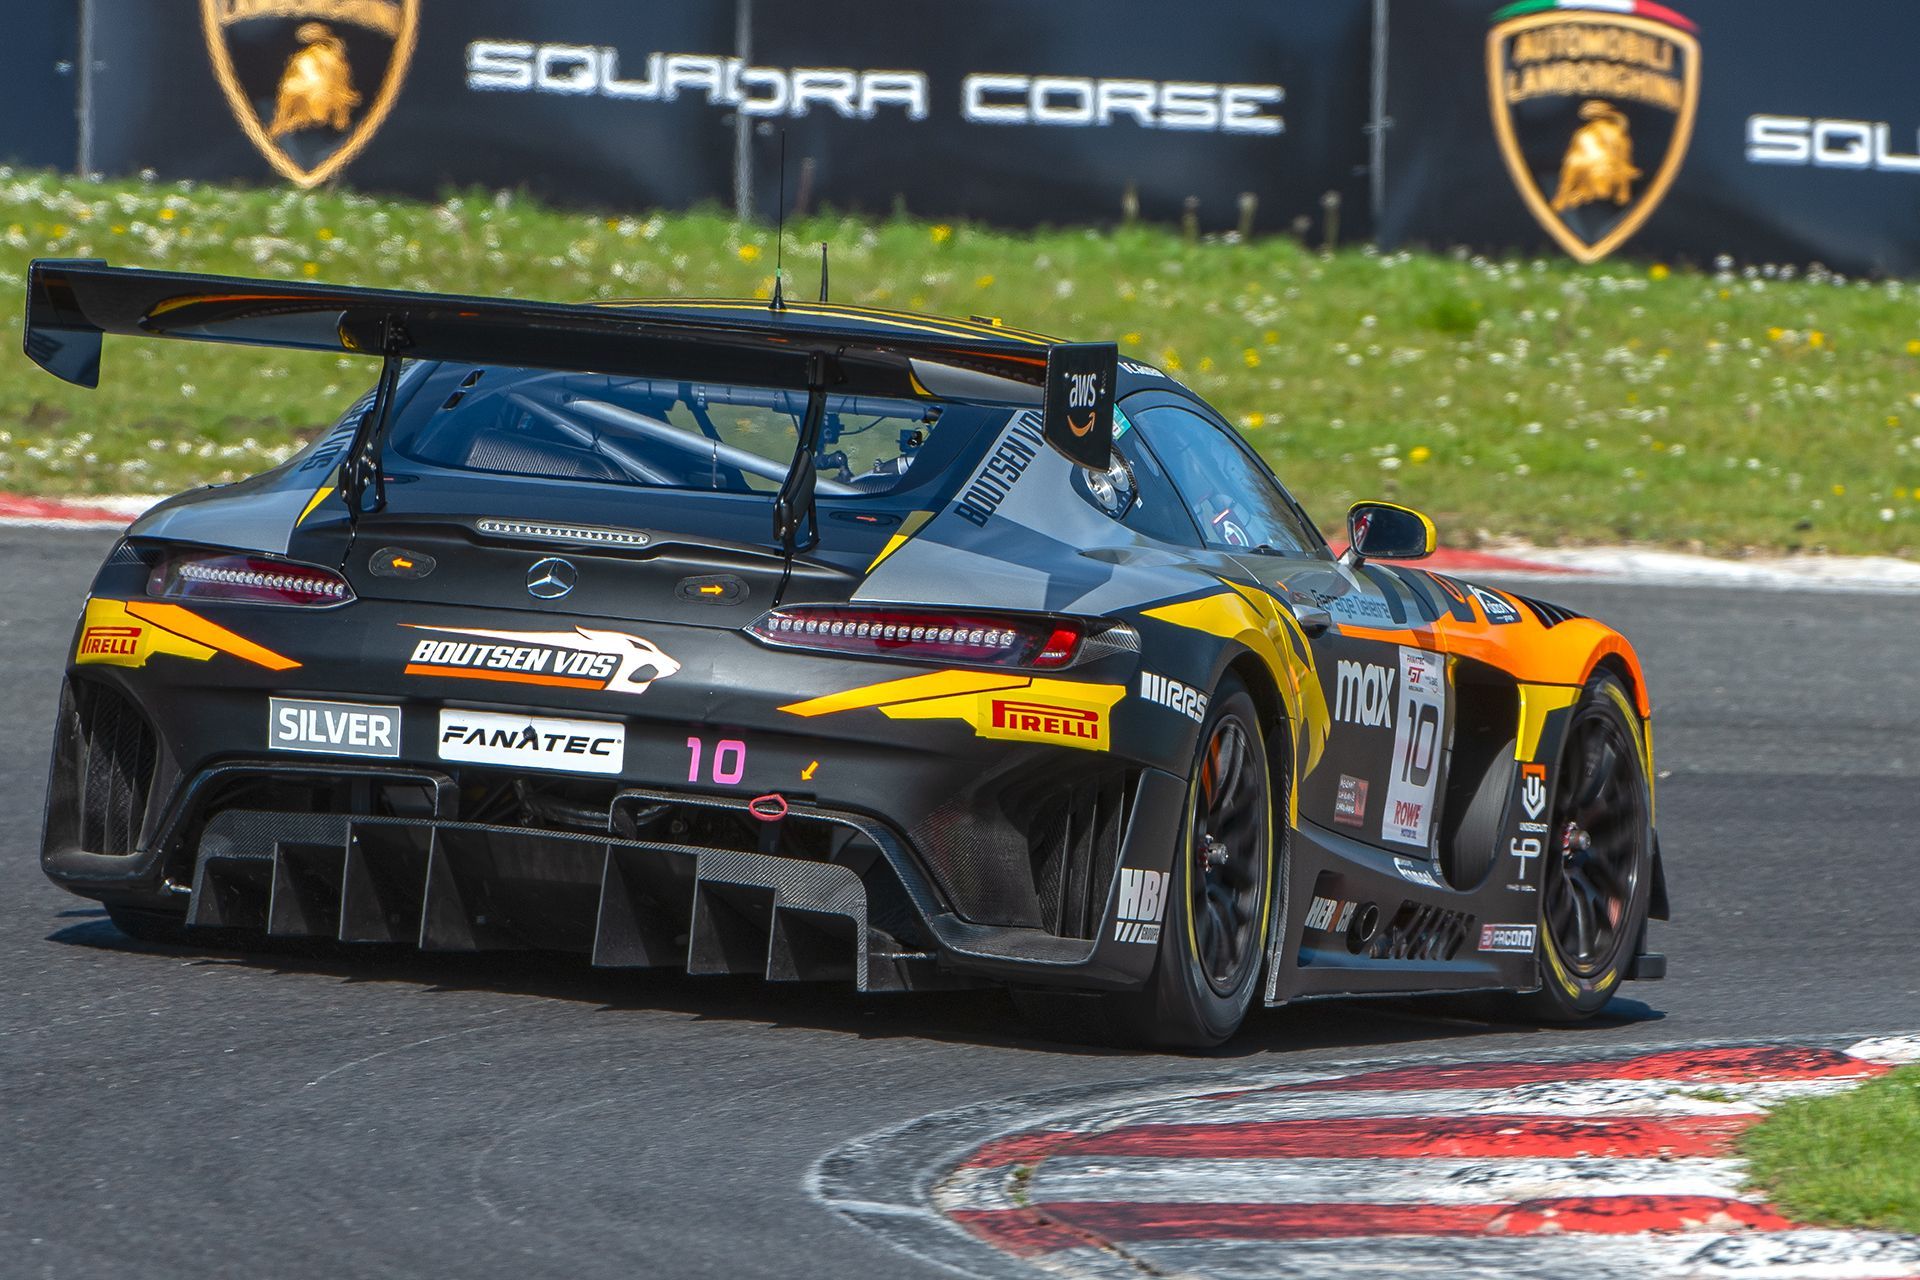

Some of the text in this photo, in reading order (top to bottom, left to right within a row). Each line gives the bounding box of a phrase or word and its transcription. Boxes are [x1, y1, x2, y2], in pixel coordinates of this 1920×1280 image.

[465, 40, 1285, 135] SQUADRA CORSE
[1069, 373, 1097, 407] aws
[953, 434, 1037, 529] BOUTSEN
[81, 626, 142, 656] PIRELLI
[412, 640, 618, 678] BOUTSEN VDS
[1166, 680, 1208, 724] RRS
[1335, 659, 1395, 728] max
[278, 707, 393, 748] SILVER
[992, 700, 1098, 740] PIRELLI
[442, 725, 615, 757] FANATEC
[686, 736, 746, 785] 10
[1402, 699, 1439, 787] 10
[1393, 800, 1423, 828] ROWE
